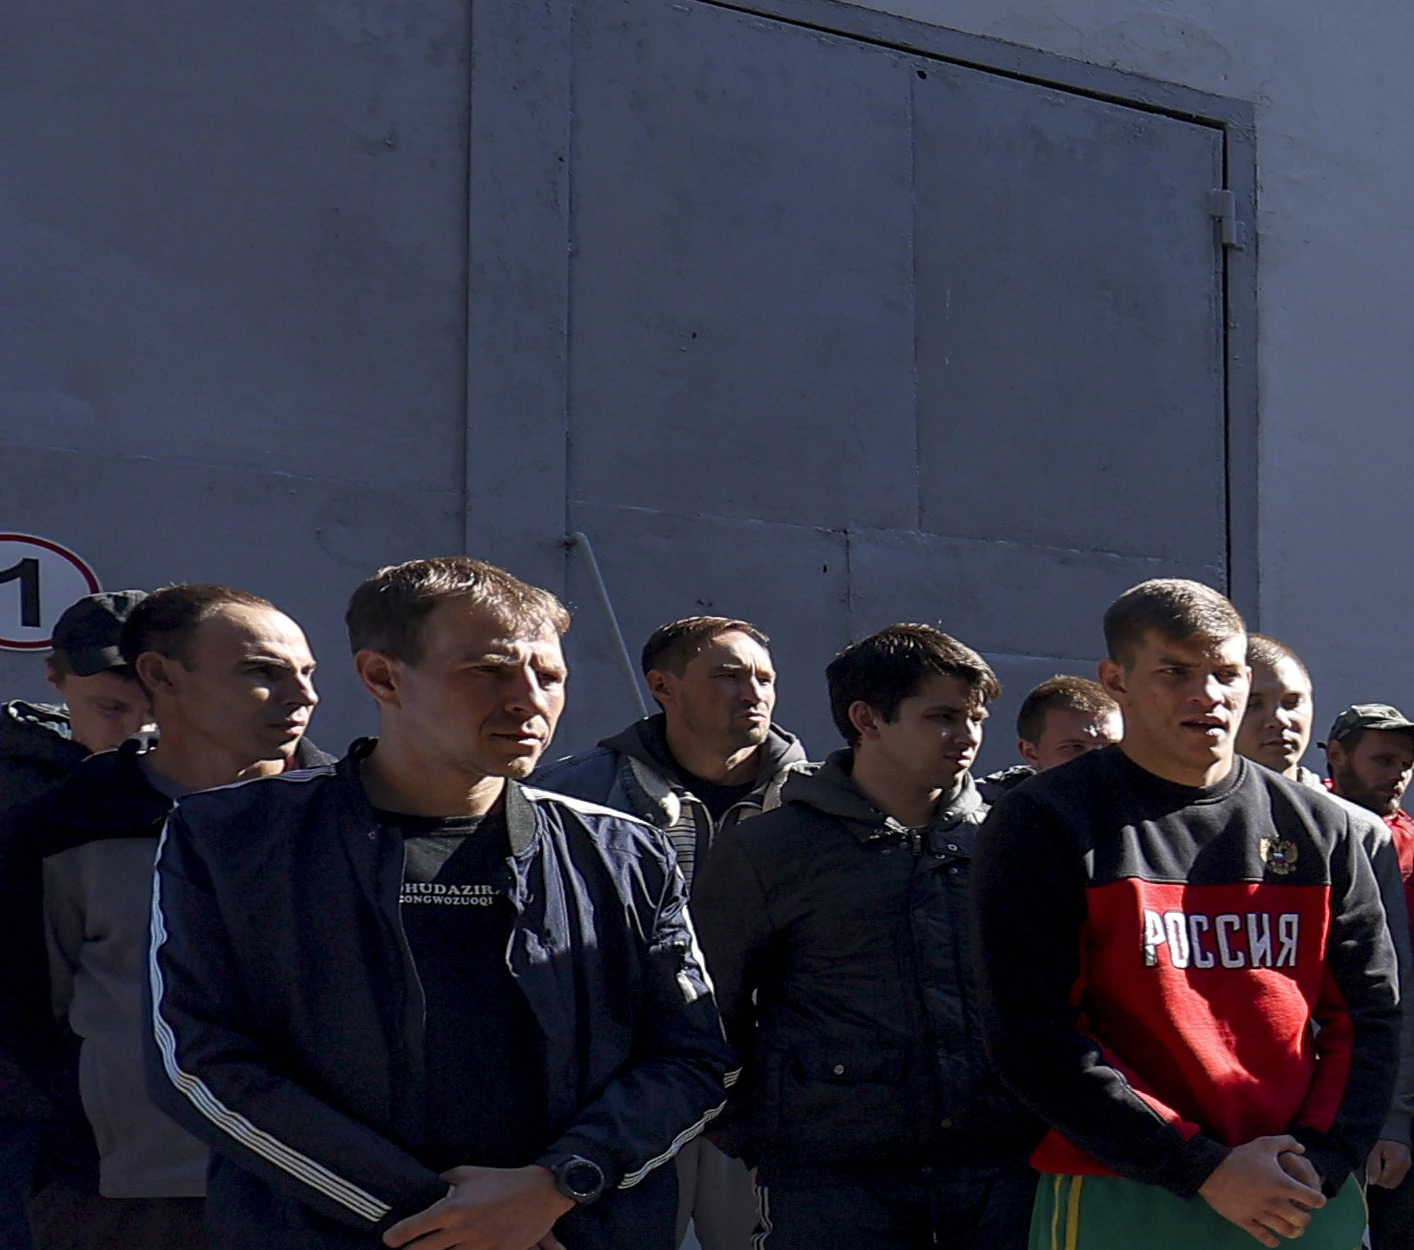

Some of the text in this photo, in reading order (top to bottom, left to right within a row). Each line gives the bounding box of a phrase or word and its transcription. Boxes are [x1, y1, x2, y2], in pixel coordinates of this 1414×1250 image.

[0, 557, 40, 628] 1
[401, 883, 500, 896] HUDAZIR
[1144, 908, 1299, 969] РОССИЯ
